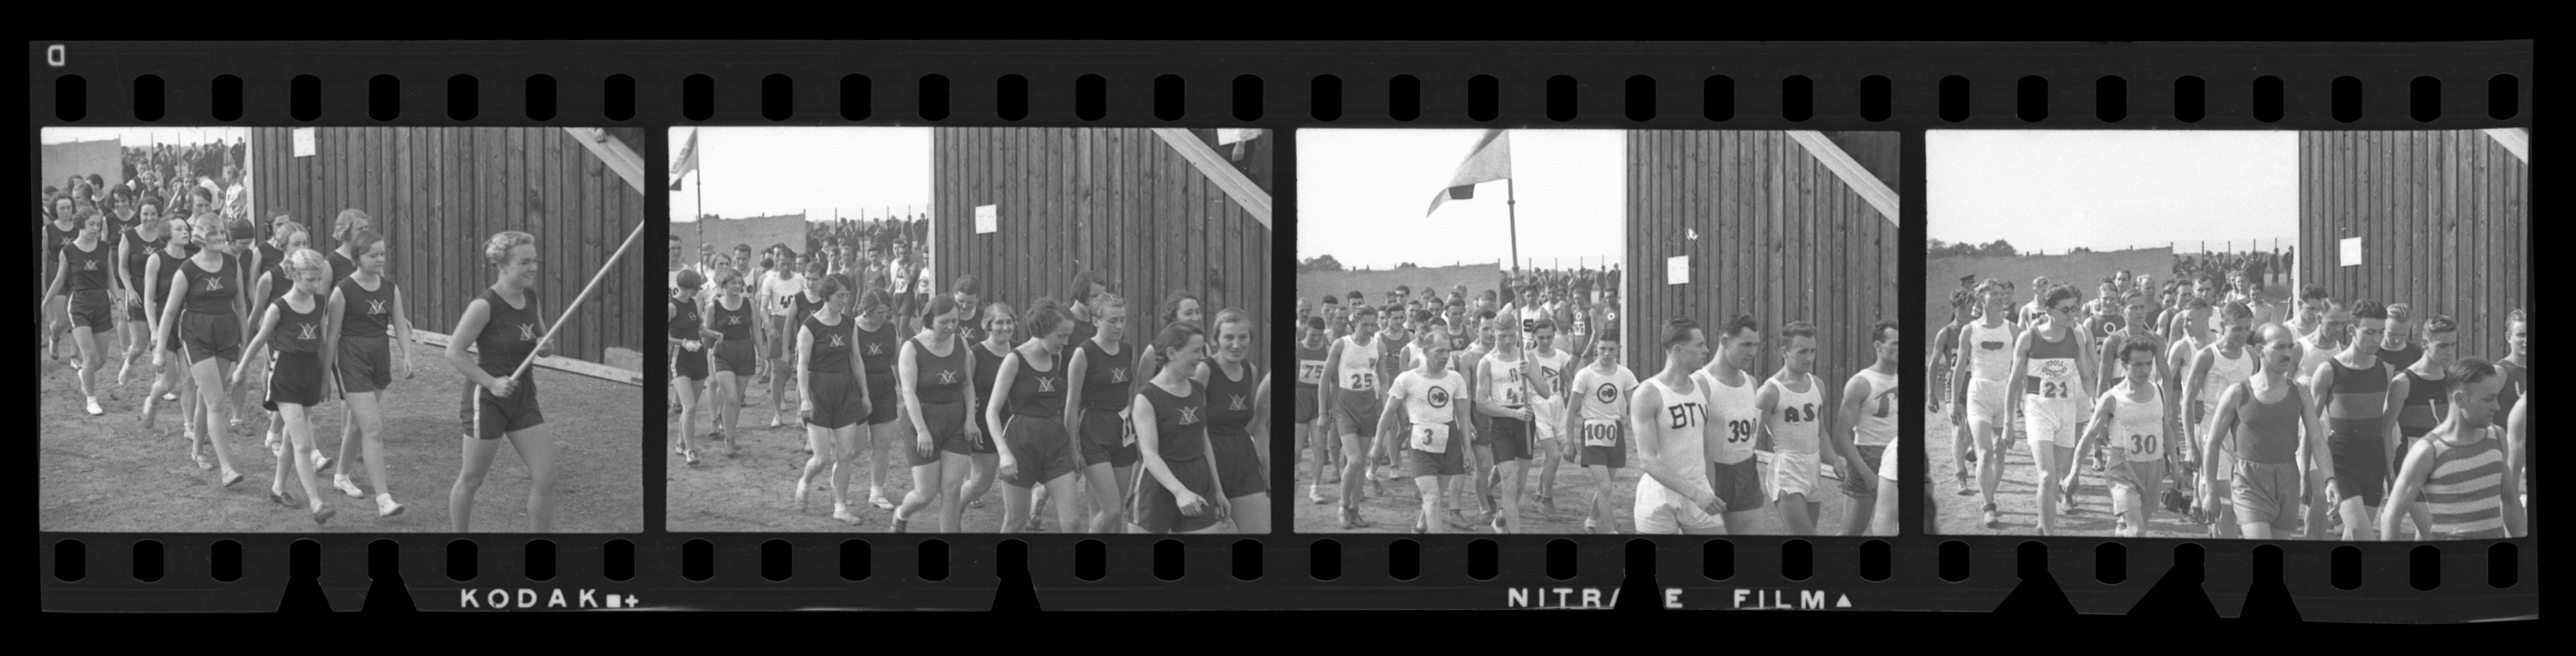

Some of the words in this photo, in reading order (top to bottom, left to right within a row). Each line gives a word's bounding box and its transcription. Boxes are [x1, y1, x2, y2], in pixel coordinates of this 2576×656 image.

[1523, 318, 1534, 332] S
[1304, 365, 1323, 379] 75
[1351, 373, 1373, 389] 25
[2044, 381, 2068, 398] 21
[1422, 429, 1434, 446] 3
[1585, 424, 1617, 441] 100
[1728, 418, 1757, 443] 390
[2130, 433, 2157, 455] 30
[461, 588, 598, 608] KODAK
[1734, 588, 1825, 609] FILM
